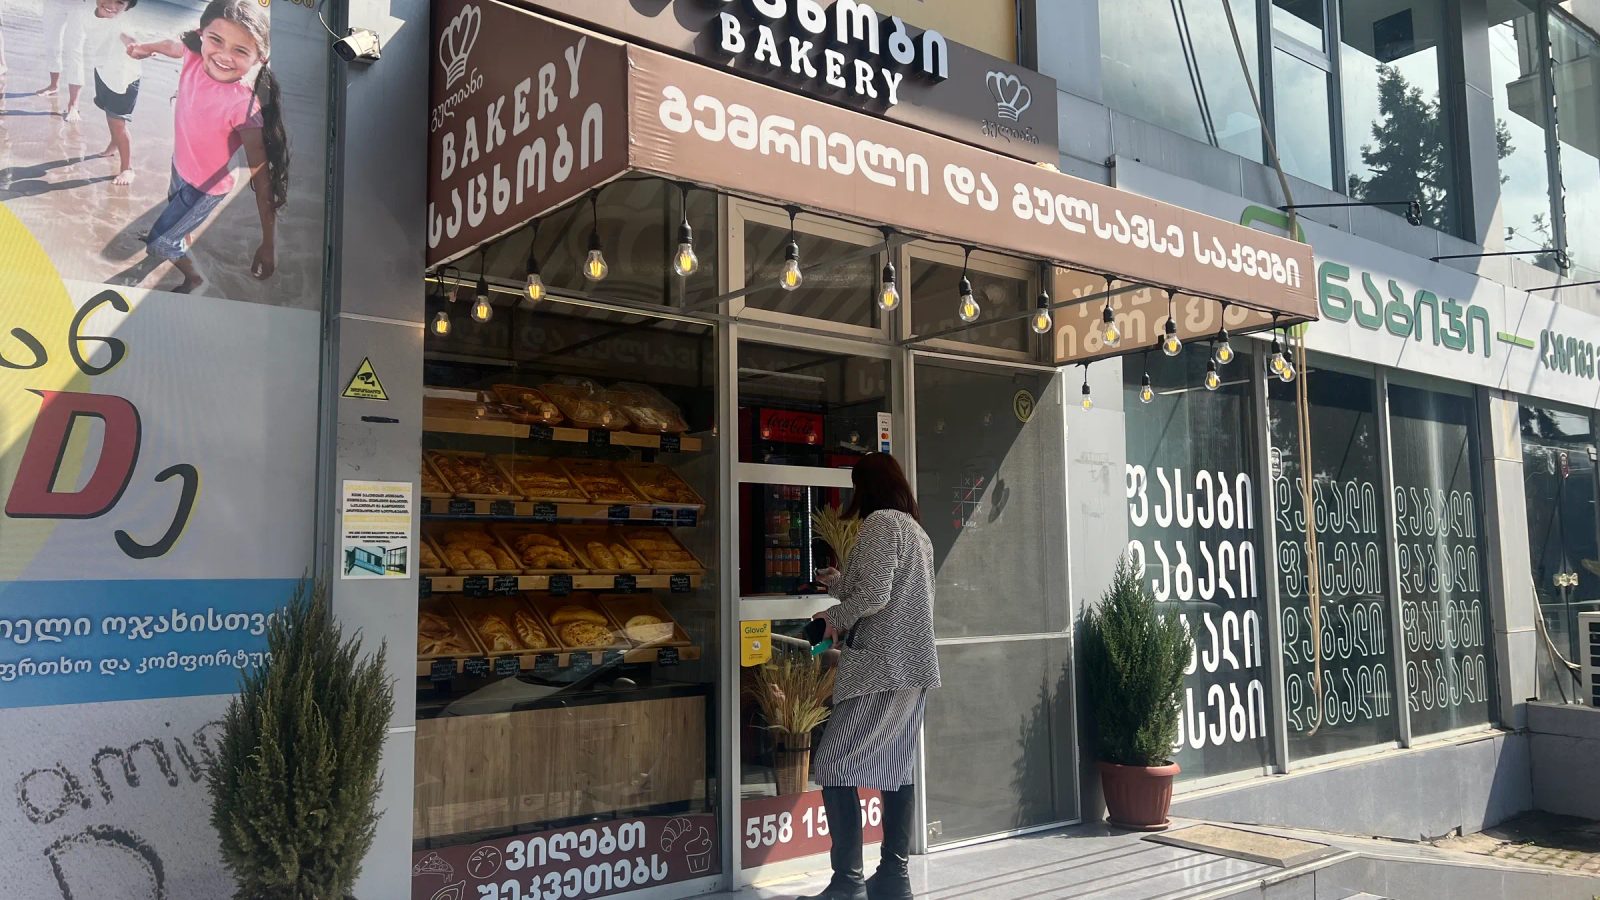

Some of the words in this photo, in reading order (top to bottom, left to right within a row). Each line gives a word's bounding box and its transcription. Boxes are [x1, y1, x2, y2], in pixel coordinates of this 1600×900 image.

[720, 12, 903, 105] BAKERY
[431, 67, 484, 133] გულიანი
[441, 35, 587, 181] BAKERY
[429, 102, 603, 249] საცხობი
[658, 85, 929, 195] გემრიელი
[943, 163, 999, 212] და
[1011, 182, 1185, 258] გულსავსე
[1192, 230, 1300, 288] საკვები
[1318, 260, 1491, 358] ნაბიჯი
[1126, 464, 1254, 529] ფასები
[1275, 476, 1377, 533] დაბალი
[1394, 486, 1476, 538] დაბალი
[1398, 543, 1480, 593] დაბალი
[1282, 602, 1385, 664] დაბალი
[1402, 599, 1485, 652] ფასები
[99, 656, 131, 676] და
[1287, 663, 1389, 731] დაბალი
[1406, 654, 1488, 711] დაბალი
[505, 820, 646, 872] ვიღებთ
[745, 811, 793, 850] 558
[802, 807, 830, 839] 15
